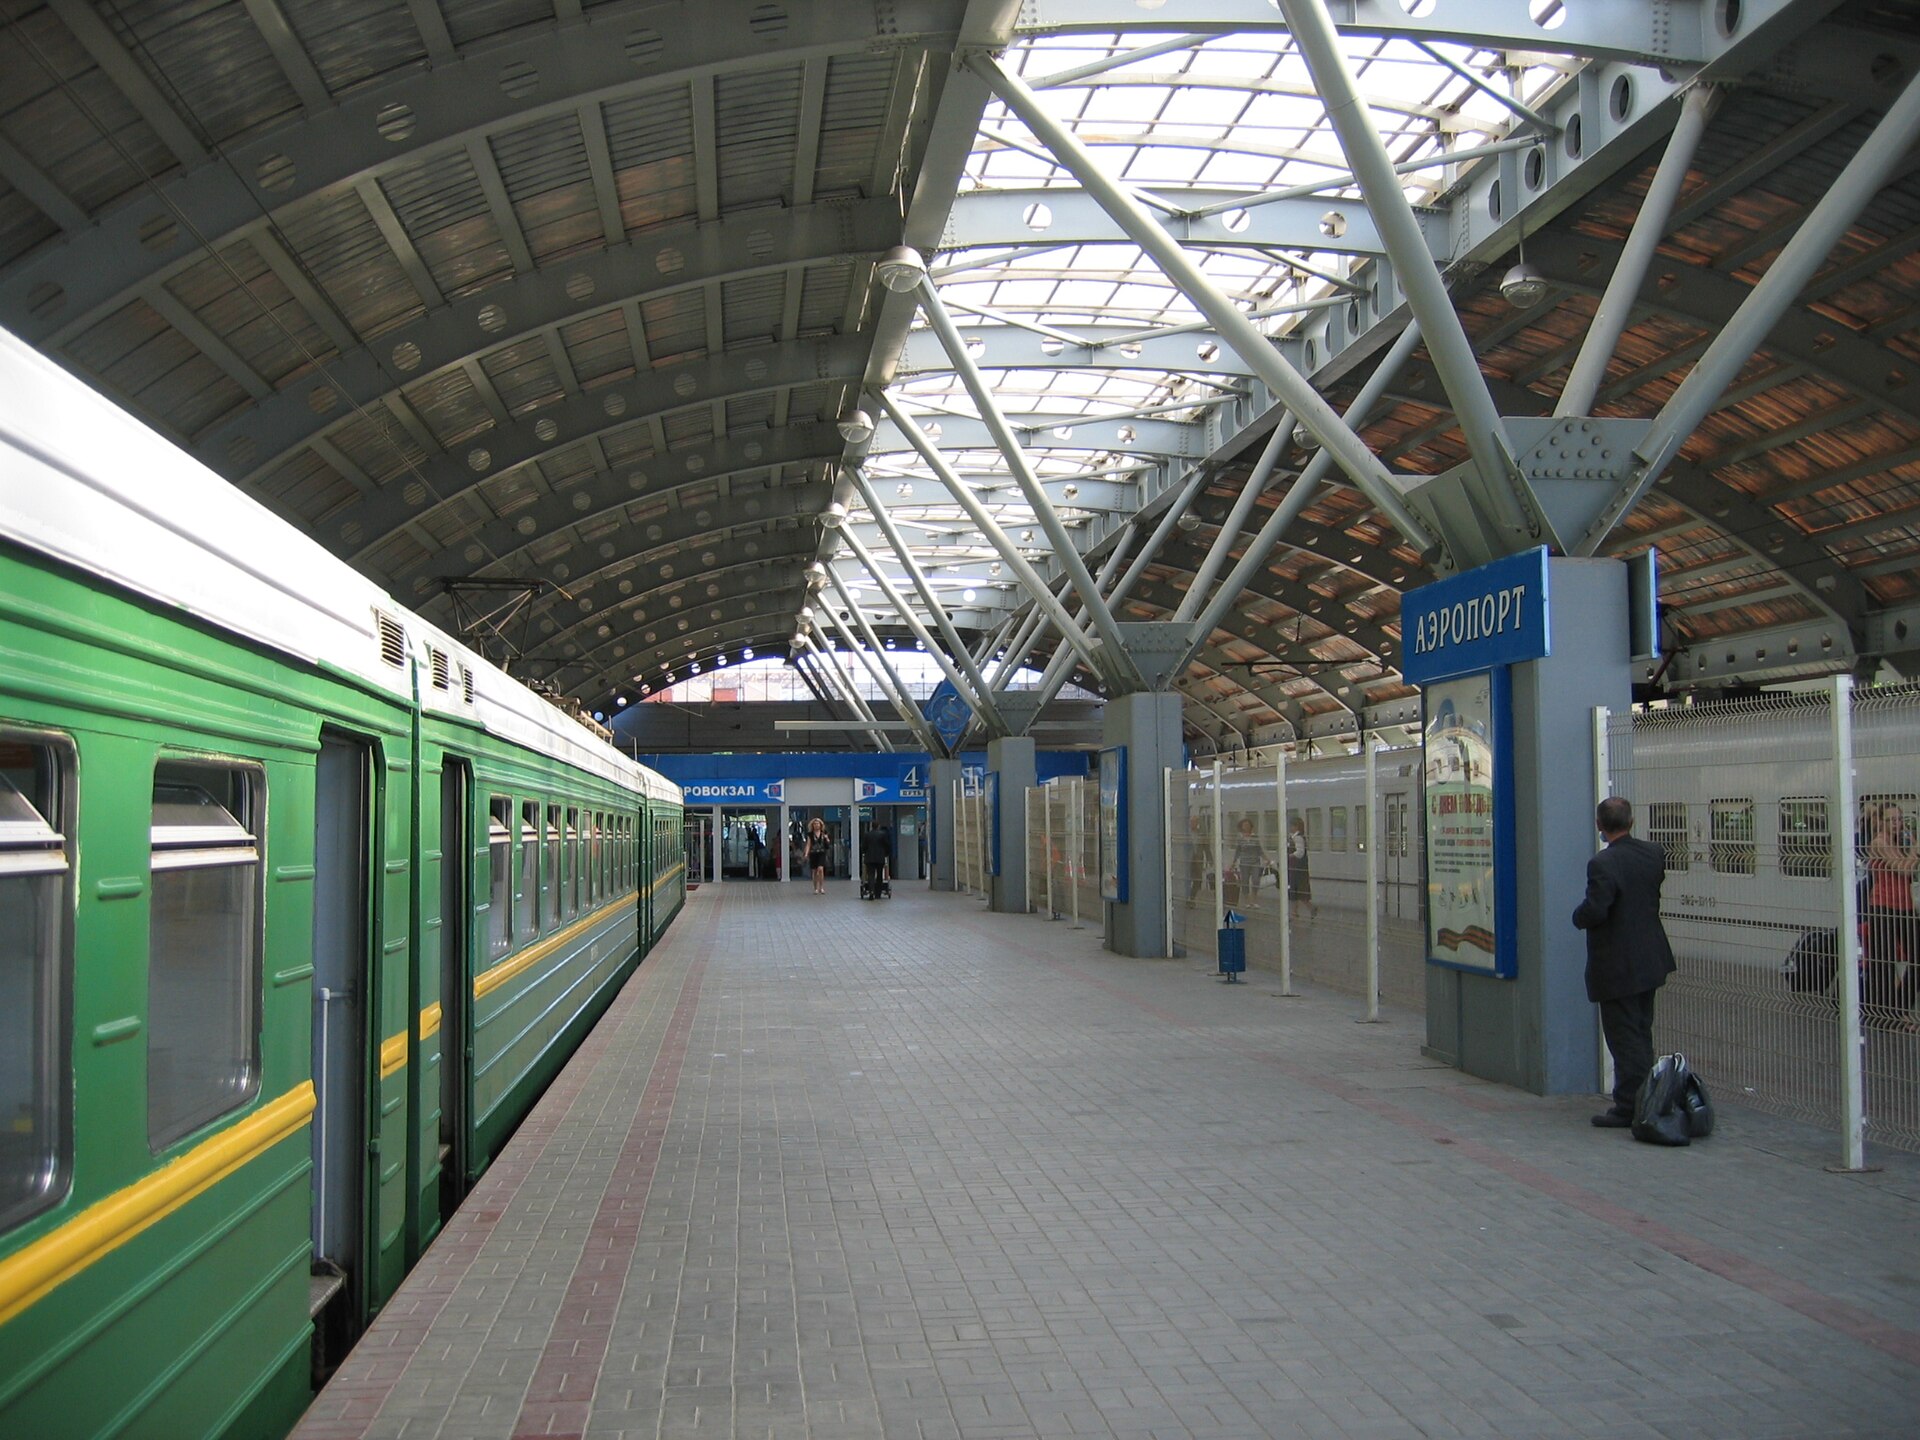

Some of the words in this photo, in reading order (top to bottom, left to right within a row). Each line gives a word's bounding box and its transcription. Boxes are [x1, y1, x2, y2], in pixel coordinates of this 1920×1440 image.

[1415, 585, 1525, 653] АЭРОПОРТ
[903, 766, 920, 788] 4
[683, 785, 755, 797] РОВОКЗАЛ
